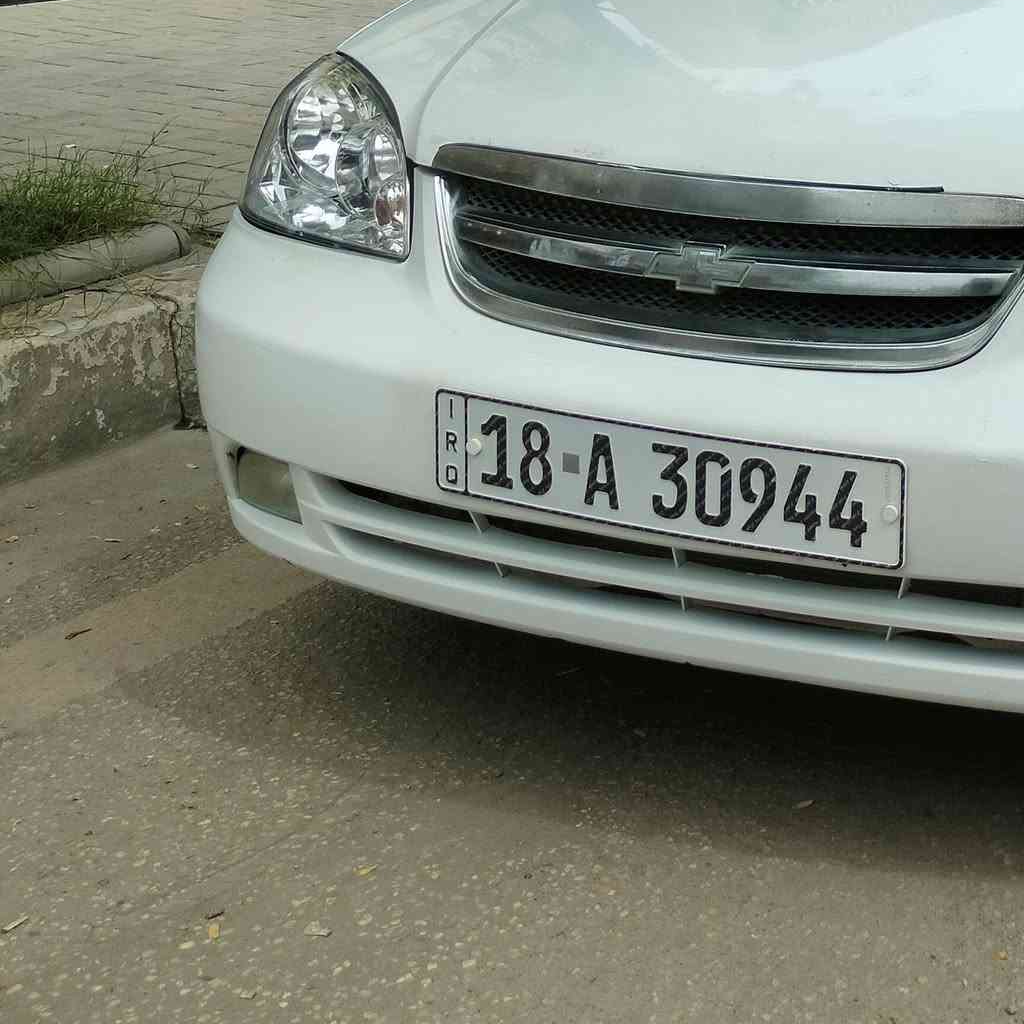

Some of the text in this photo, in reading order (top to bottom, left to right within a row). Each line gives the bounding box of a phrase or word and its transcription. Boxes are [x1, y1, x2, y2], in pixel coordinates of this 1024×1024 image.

[480, 414, 868, 549] 18 A 30944
